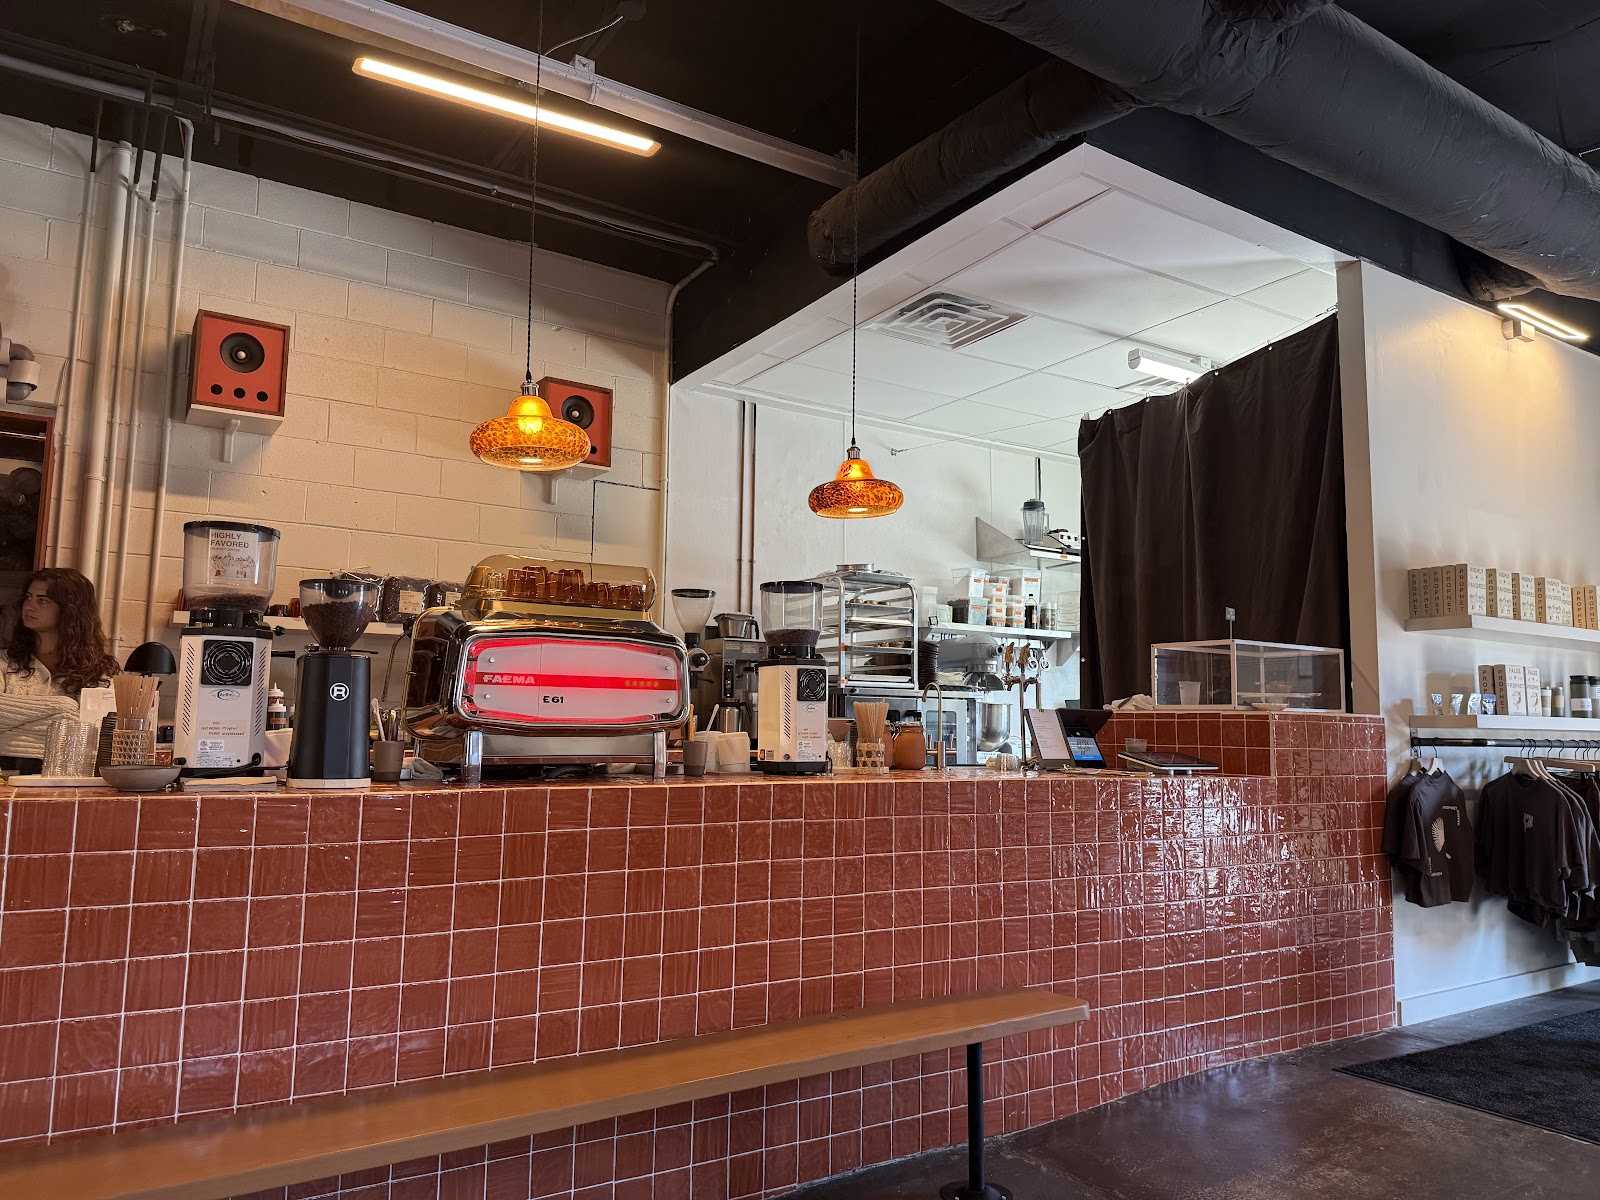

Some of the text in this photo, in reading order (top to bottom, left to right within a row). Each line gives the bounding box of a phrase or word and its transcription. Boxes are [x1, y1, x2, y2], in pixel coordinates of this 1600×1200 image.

[211, 532, 242, 540] HIGHLY
[210, 540, 249, 549] FAVORED
[1469, 567, 1484, 575] HIGHLY
[1468, 582, 1486, 590] FAVORED
[1588, 589, 1596, 628] PROPHET
[482, 674, 536, 684] FAEMA
[1498, 669, 1506, 712] PROPHET
